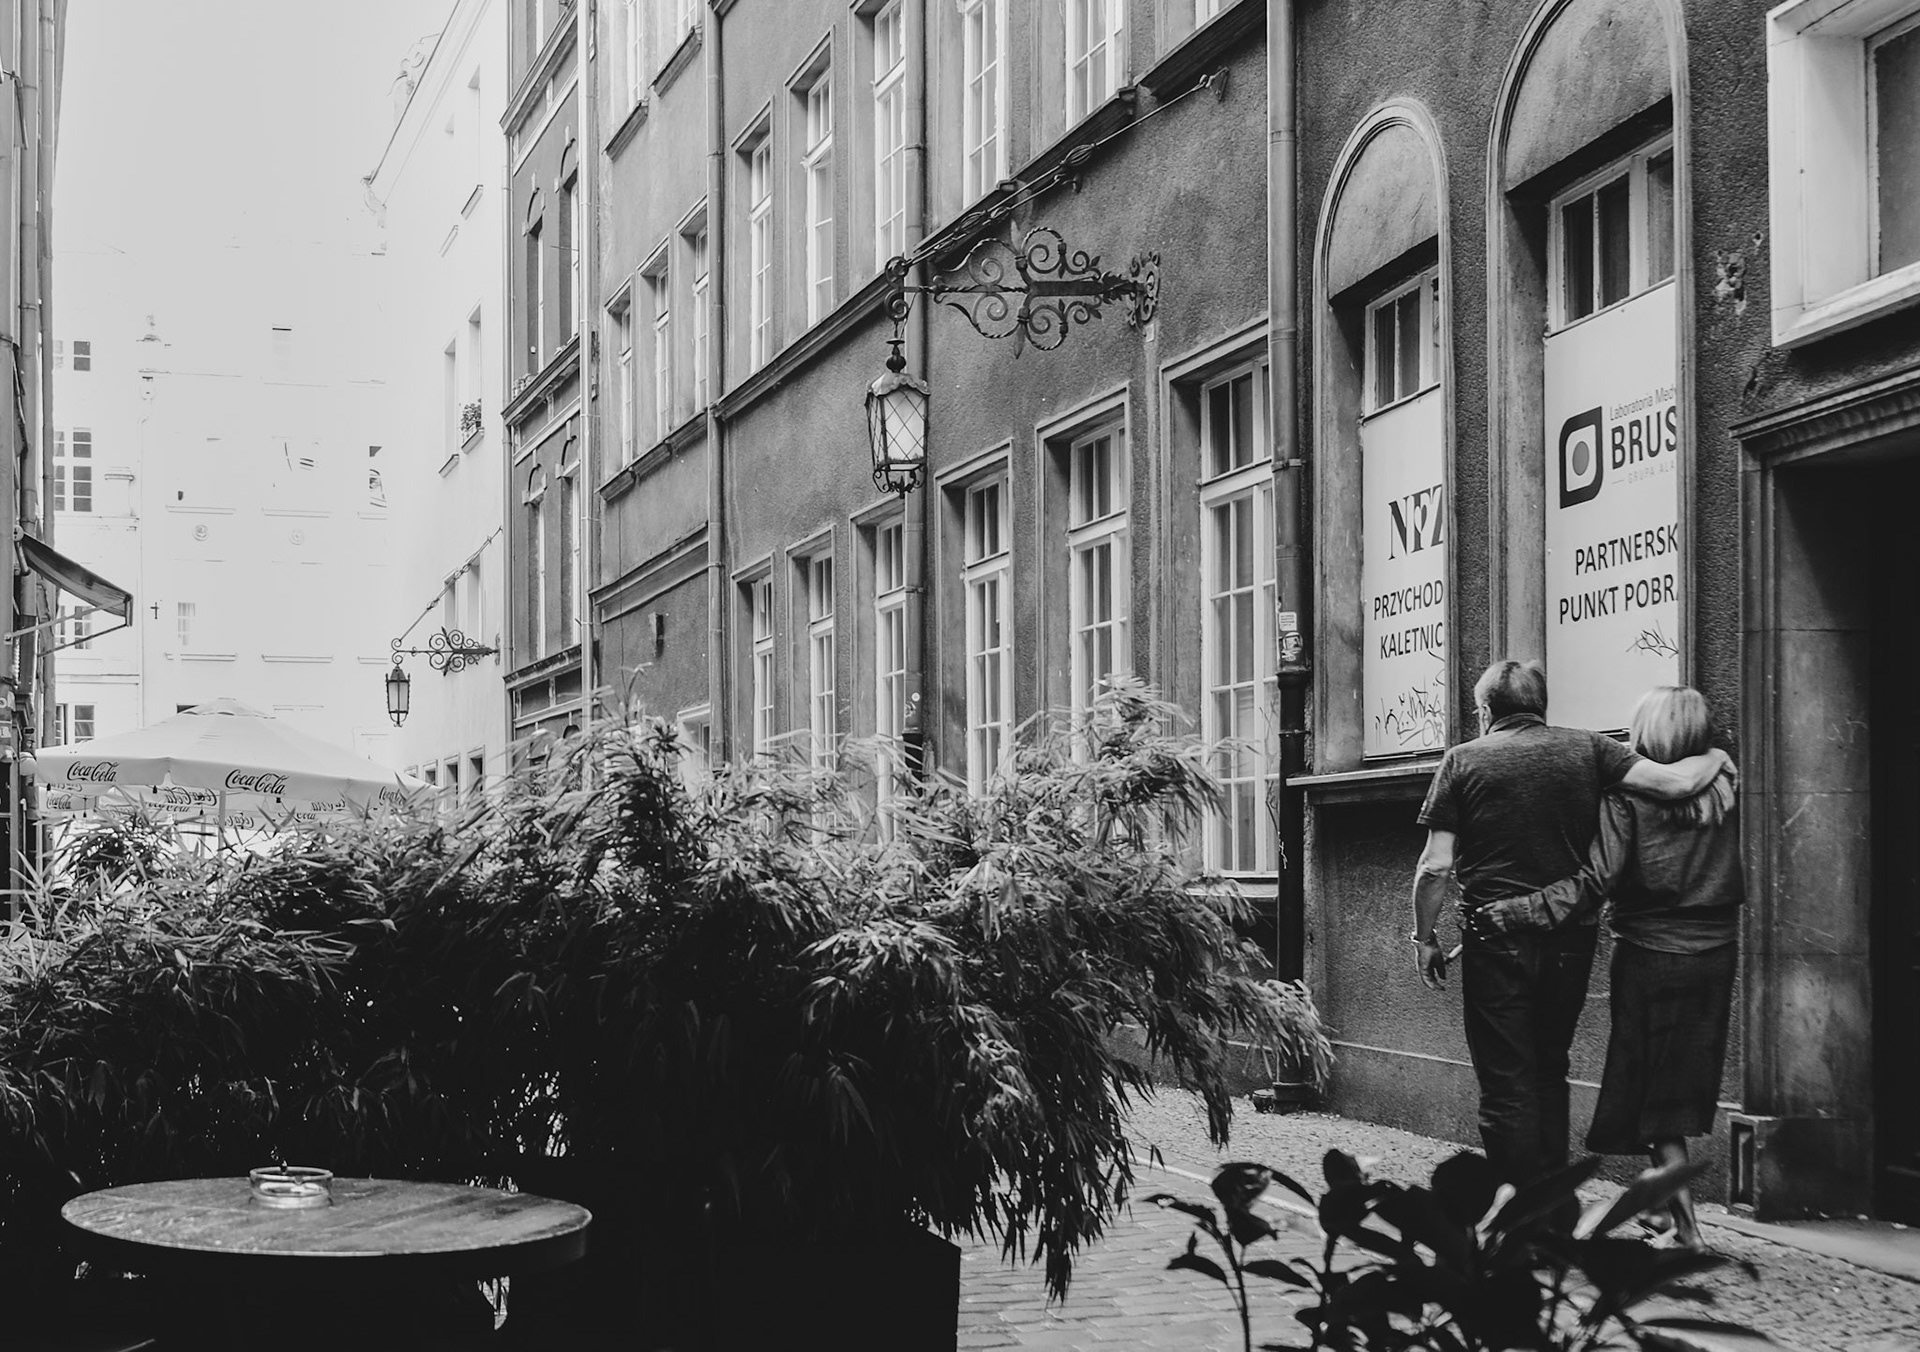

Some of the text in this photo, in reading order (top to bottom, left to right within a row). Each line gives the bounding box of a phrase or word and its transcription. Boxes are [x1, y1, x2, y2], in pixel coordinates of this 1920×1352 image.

[1611, 405, 1677, 470] BRUS
[1388, 484, 1443, 560] NFZ
[1575, 522, 1678, 576] PARTNERSK
[1374, 580, 1444, 621] PRZYCHOD
[1560, 574, 1678, 625] PUNKT POBR
[1380, 622, 1445, 660] KALETNIC
